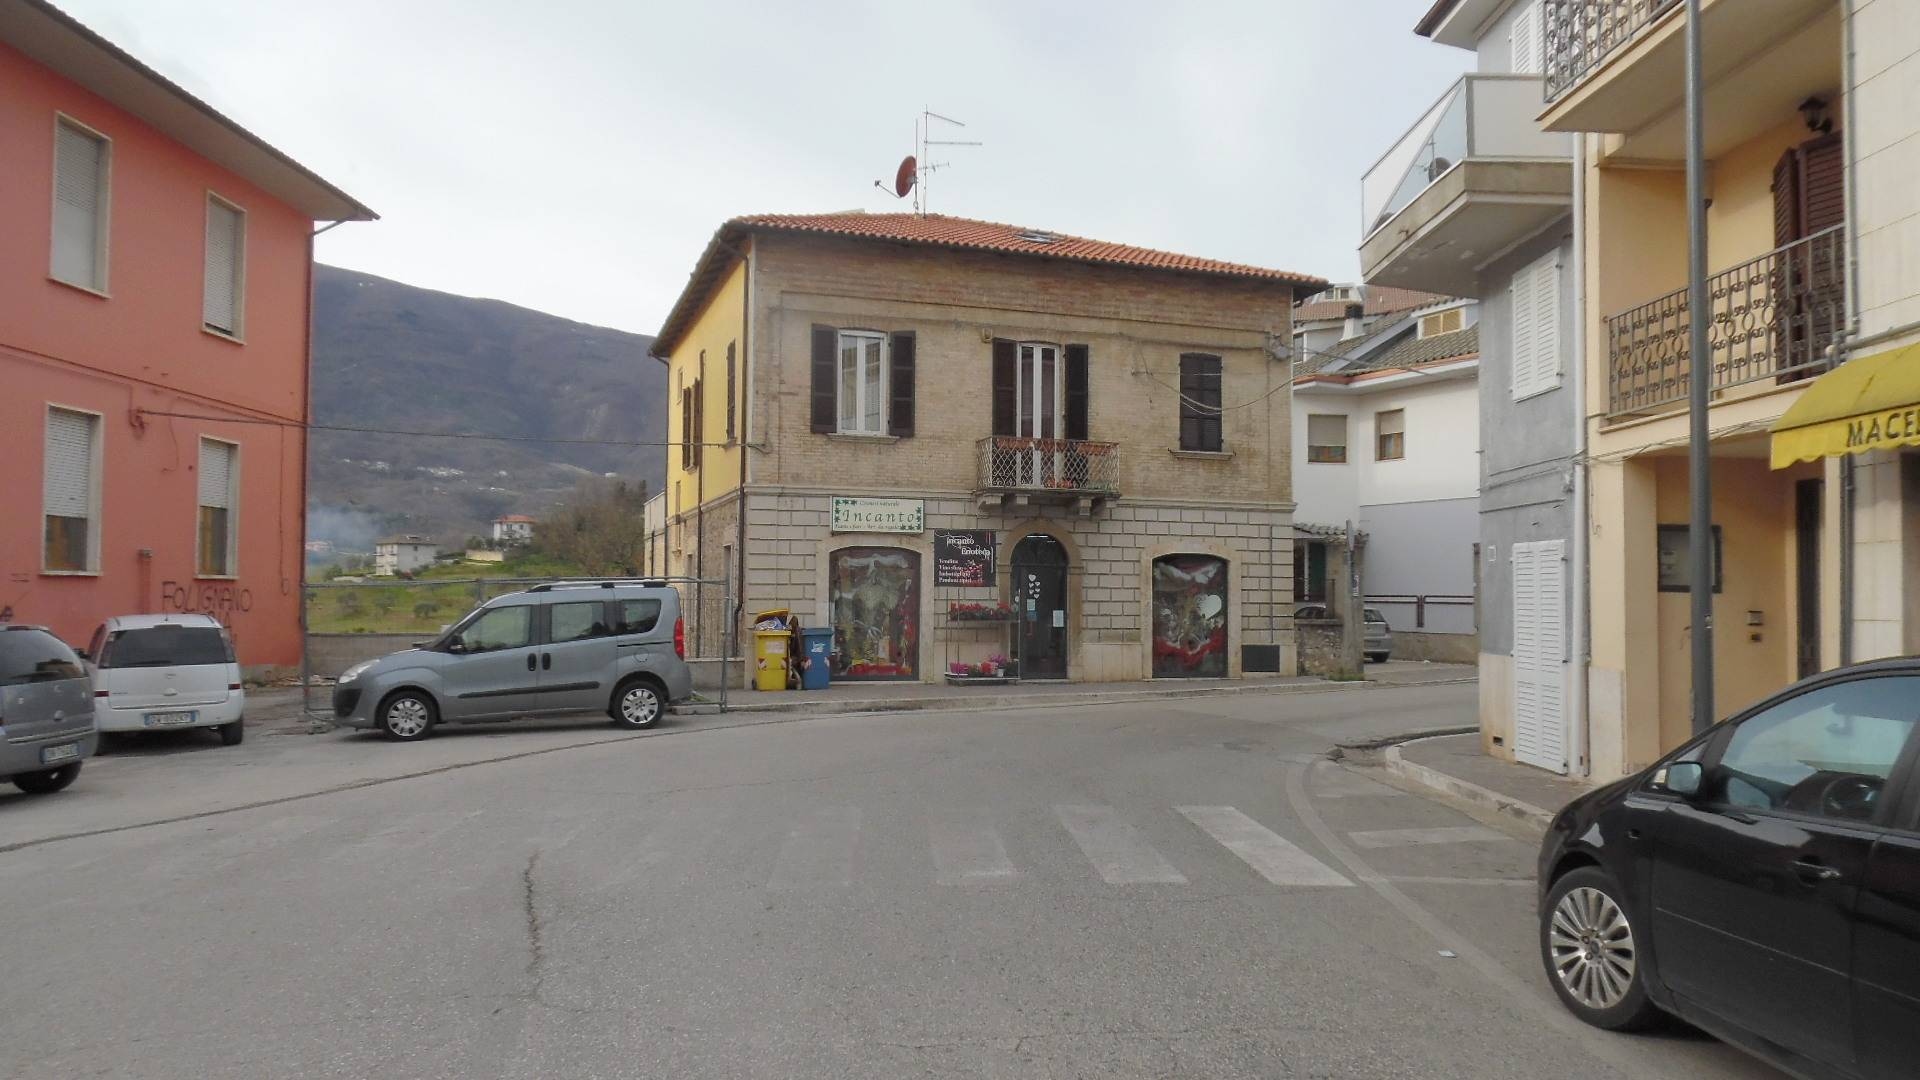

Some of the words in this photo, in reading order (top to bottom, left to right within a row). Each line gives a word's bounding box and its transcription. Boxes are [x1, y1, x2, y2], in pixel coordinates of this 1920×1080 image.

[1845, 408, 1920, 448] MACE
[842, 509, 914, 523] Incanto
[946, 534, 975, 548] Incanto
[162, 581, 252, 612] FOLIGNANO
